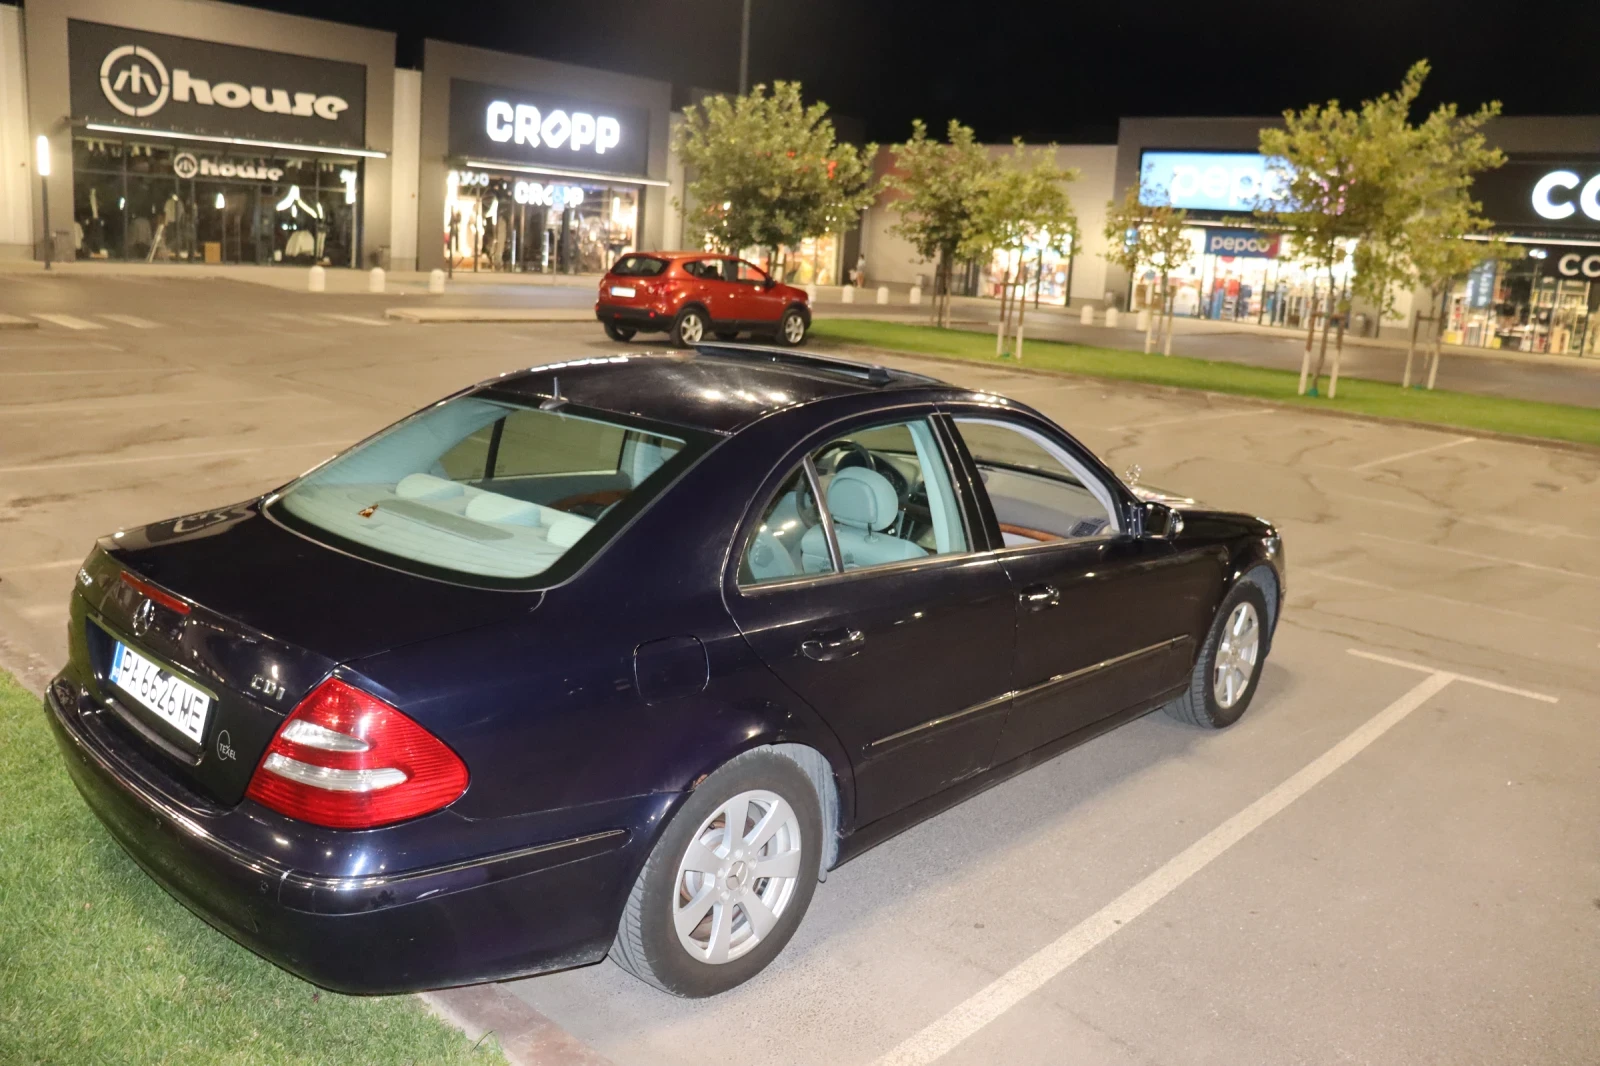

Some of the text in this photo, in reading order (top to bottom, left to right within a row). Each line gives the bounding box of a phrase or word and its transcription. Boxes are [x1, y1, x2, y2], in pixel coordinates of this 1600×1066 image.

[173, 69, 348, 120] house
[486, 100, 621, 154] CROPP
[200, 158, 284, 181] house
[1210, 235, 1271, 254] pepco
[140, 665, 178, 716] 6626
[251, 673, 286, 701] CDI
[219, 742, 237, 761] TEXEL
